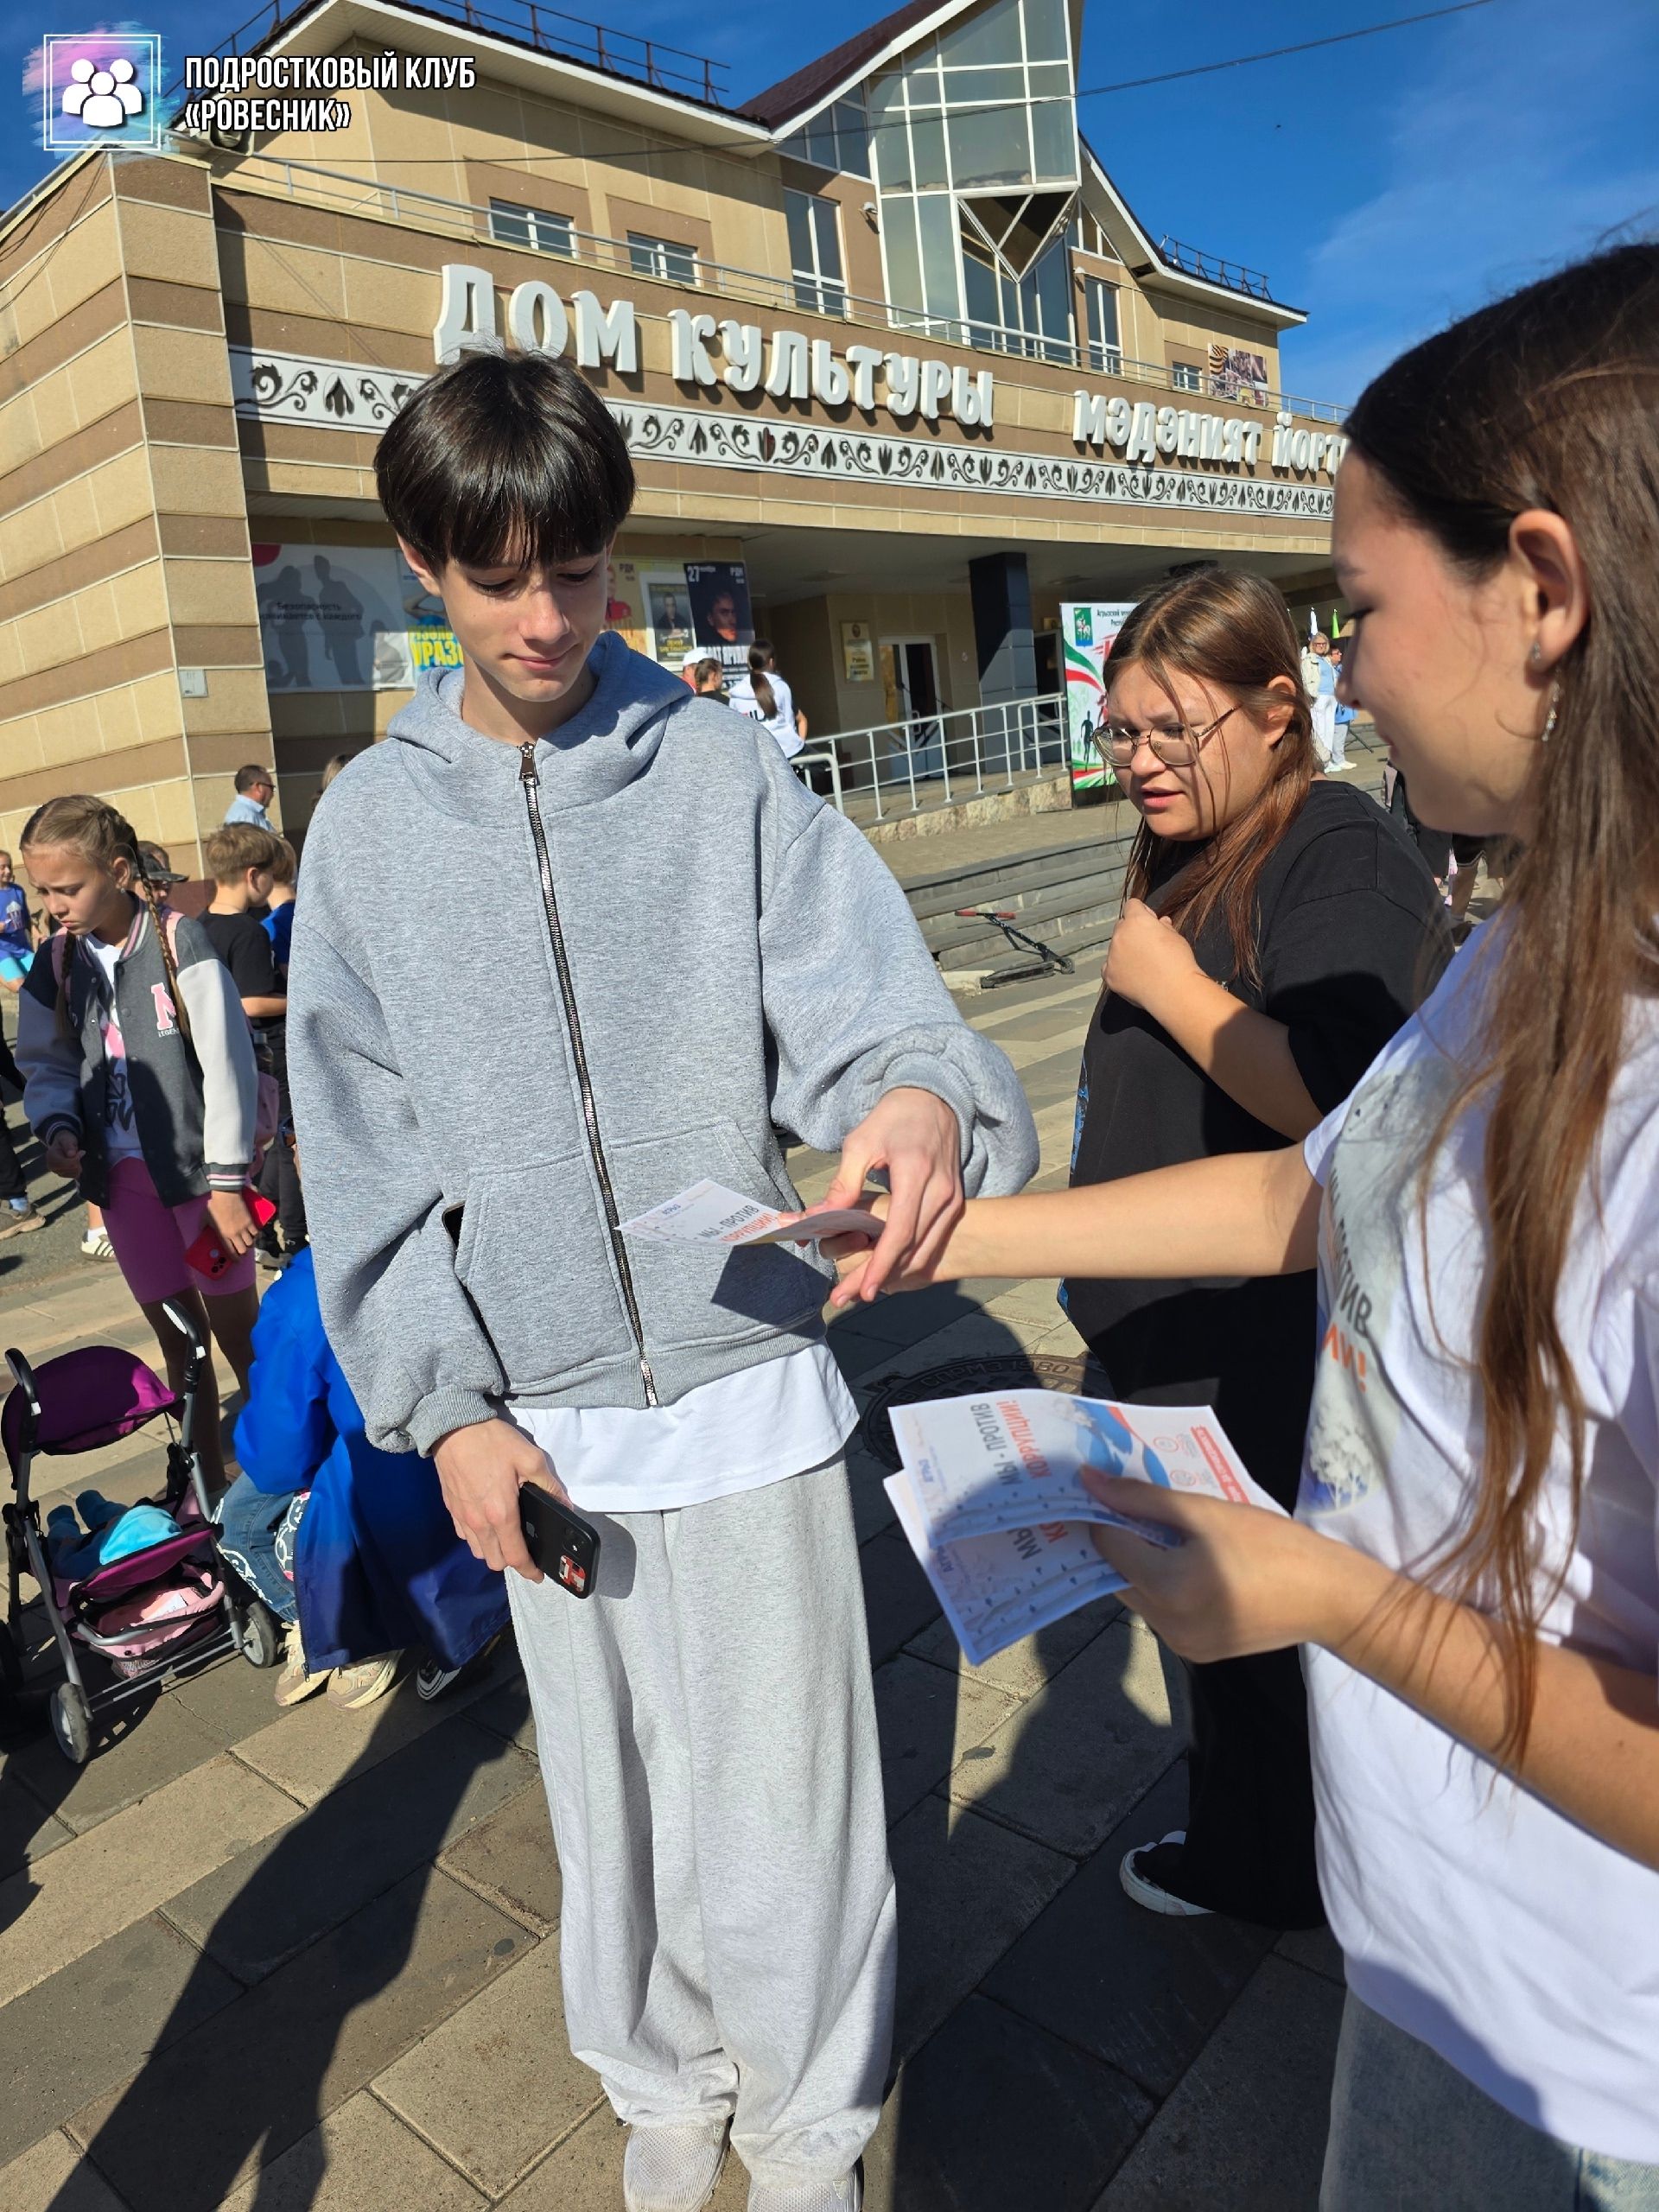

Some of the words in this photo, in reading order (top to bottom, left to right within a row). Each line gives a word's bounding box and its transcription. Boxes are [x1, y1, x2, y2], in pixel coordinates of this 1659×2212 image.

[433, 264, 638, 373] ДОМ
[667, 308, 995, 428] КУЛЬТУРЫ
[722, 1205, 760, 1227] ПРОТИВ
[969, 1402, 1005, 1452] ПРОТИВ
[996, 1399, 1052, 1479] КОРРУПЦИИ!
[994, 1459, 1022, 1485] МЫ
